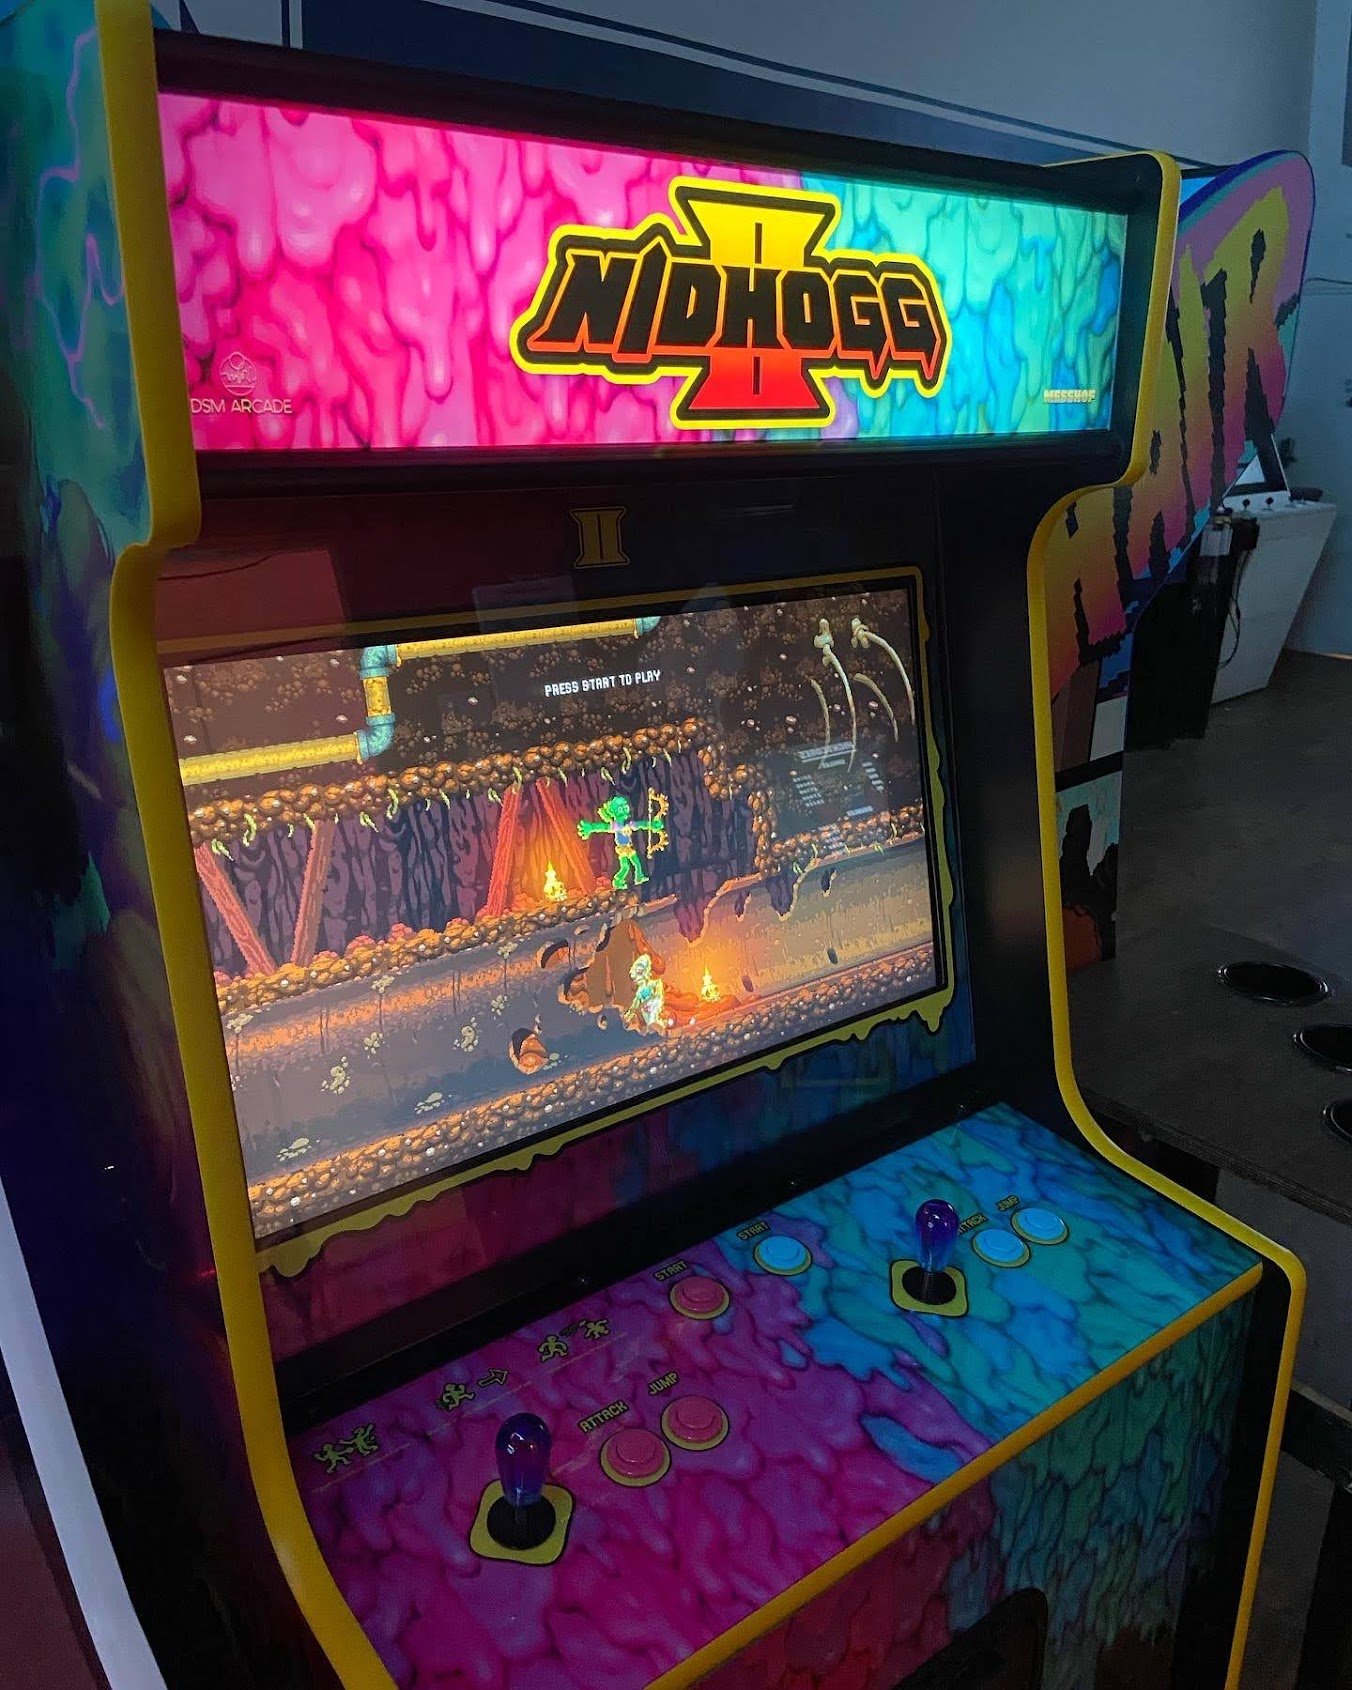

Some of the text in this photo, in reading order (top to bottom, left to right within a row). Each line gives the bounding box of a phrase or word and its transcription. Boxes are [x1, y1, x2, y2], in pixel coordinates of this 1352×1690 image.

[524, 236, 944, 381] NIDHOGG
[190, 398, 293, 414] DSM ARCADE
[544, 669, 661, 697] PRESS START TO PLAY
[737, 1220, 770, 1241] START
[654, 1261, 688, 1281] START
[649, 1372, 678, 1395] JUMP
[578, 1400, 628, 1433] ATTACK
